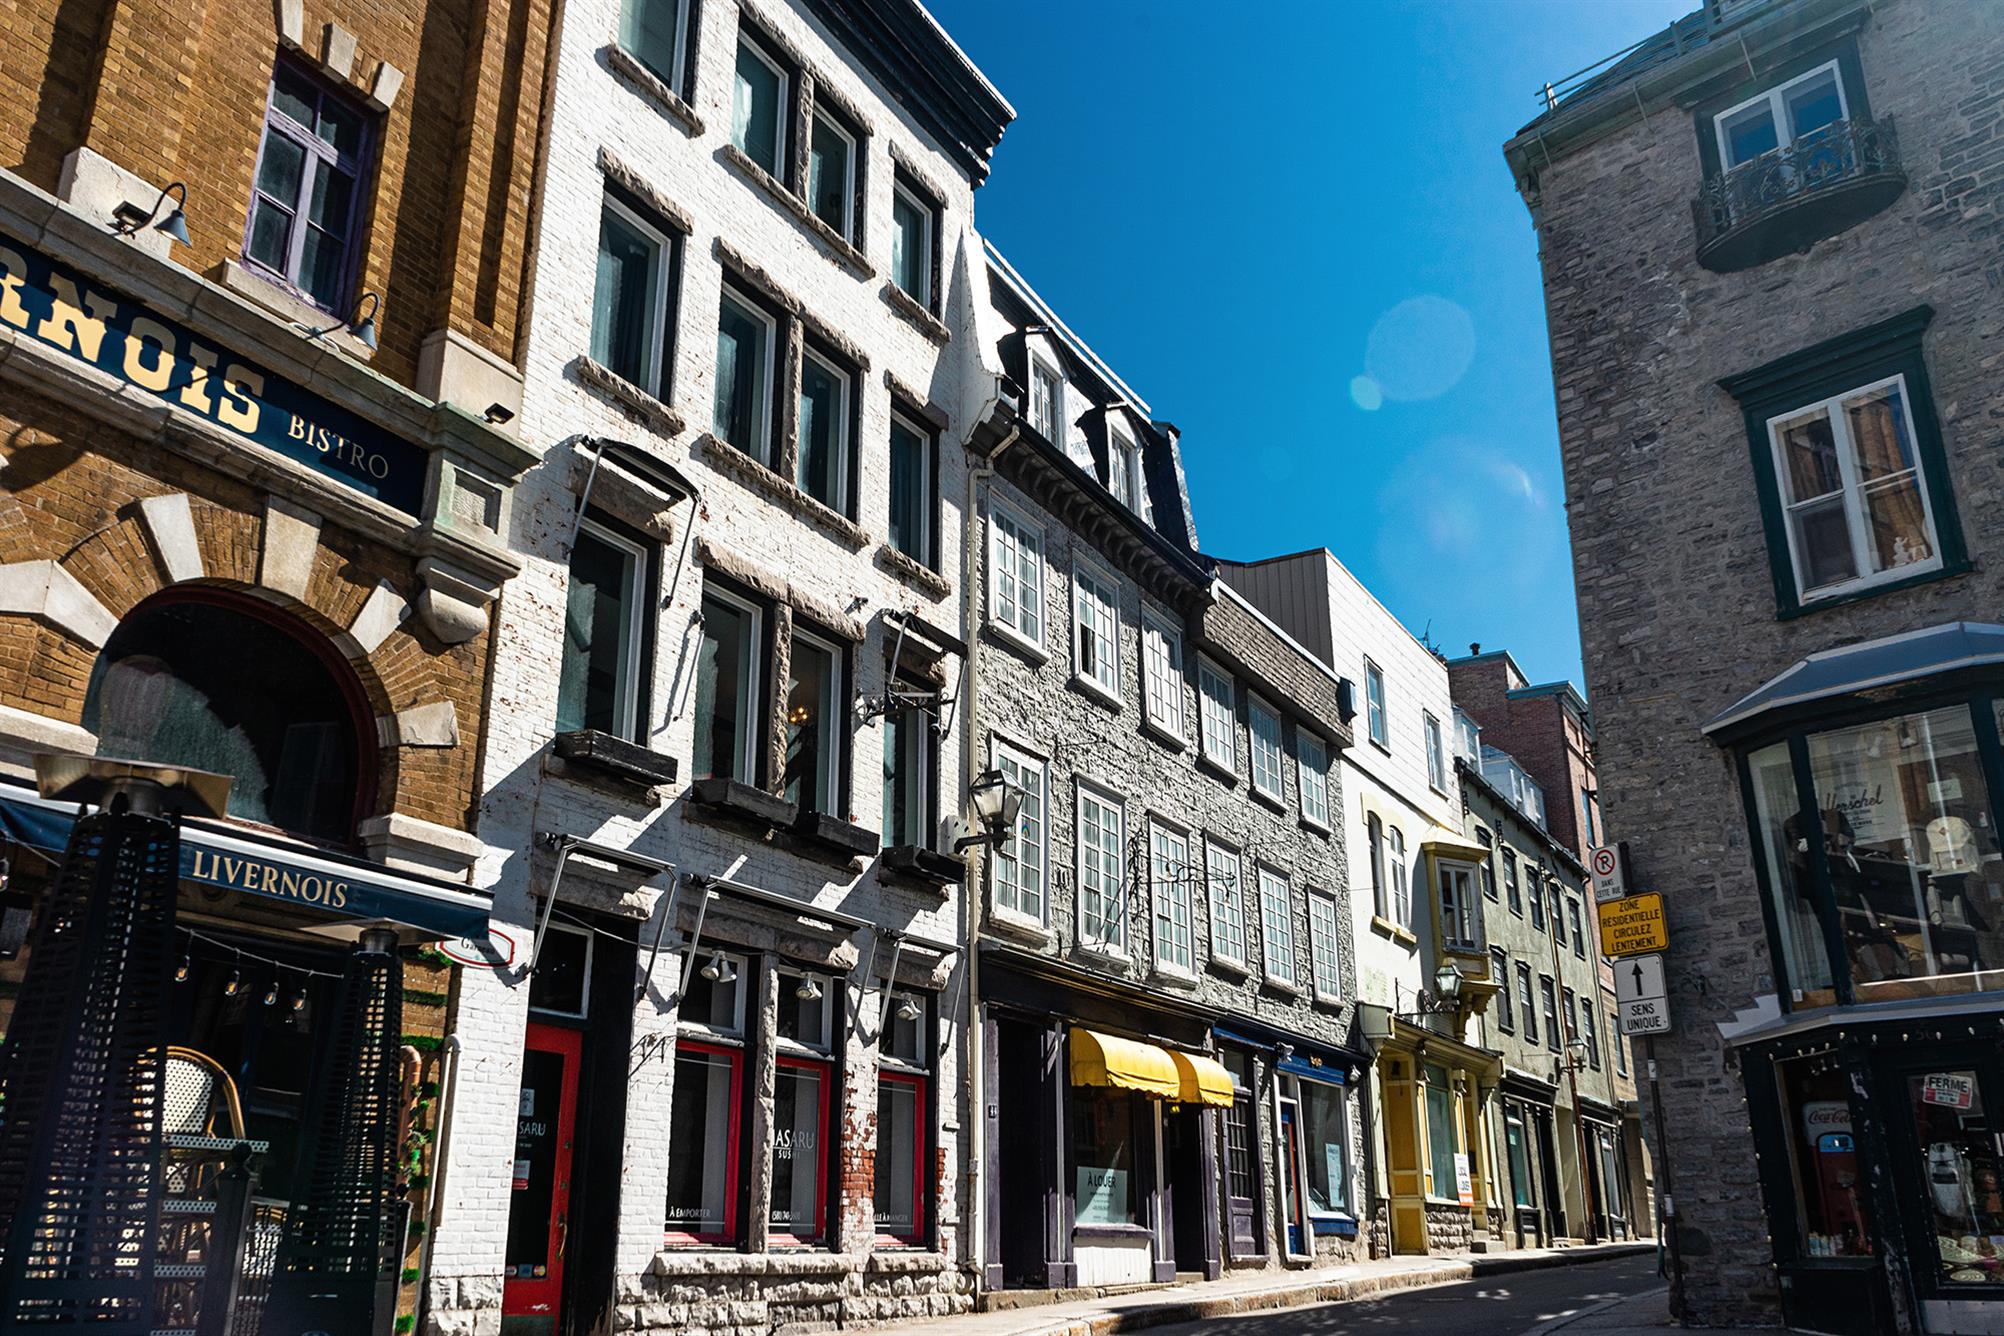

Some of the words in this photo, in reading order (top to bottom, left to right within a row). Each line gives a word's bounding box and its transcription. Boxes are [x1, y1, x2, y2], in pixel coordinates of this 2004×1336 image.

[287, 413, 389, 479] BISTRO
[192, 850, 349, 909] LIVERNOIS
[1601, 878, 1614, 888] DANS
[1611, 886, 1621, 895] RUE
[1618, 900, 1640, 912] ZONE
[1613, 924, 1652, 939] CIRCULEZ
[1611, 936, 1656, 952] LENTEMENT
[1631, 1002, 1655, 1016] SENS
[1627, 1016, 1662, 1031] UNIQUE
[518, 1121, 546, 1136] SARU
[1094, 1175, 1117, 1188] LOUER
[669, 1204, 675, 1218] À
[676, 1207, 711, 1218] EMPORTER
